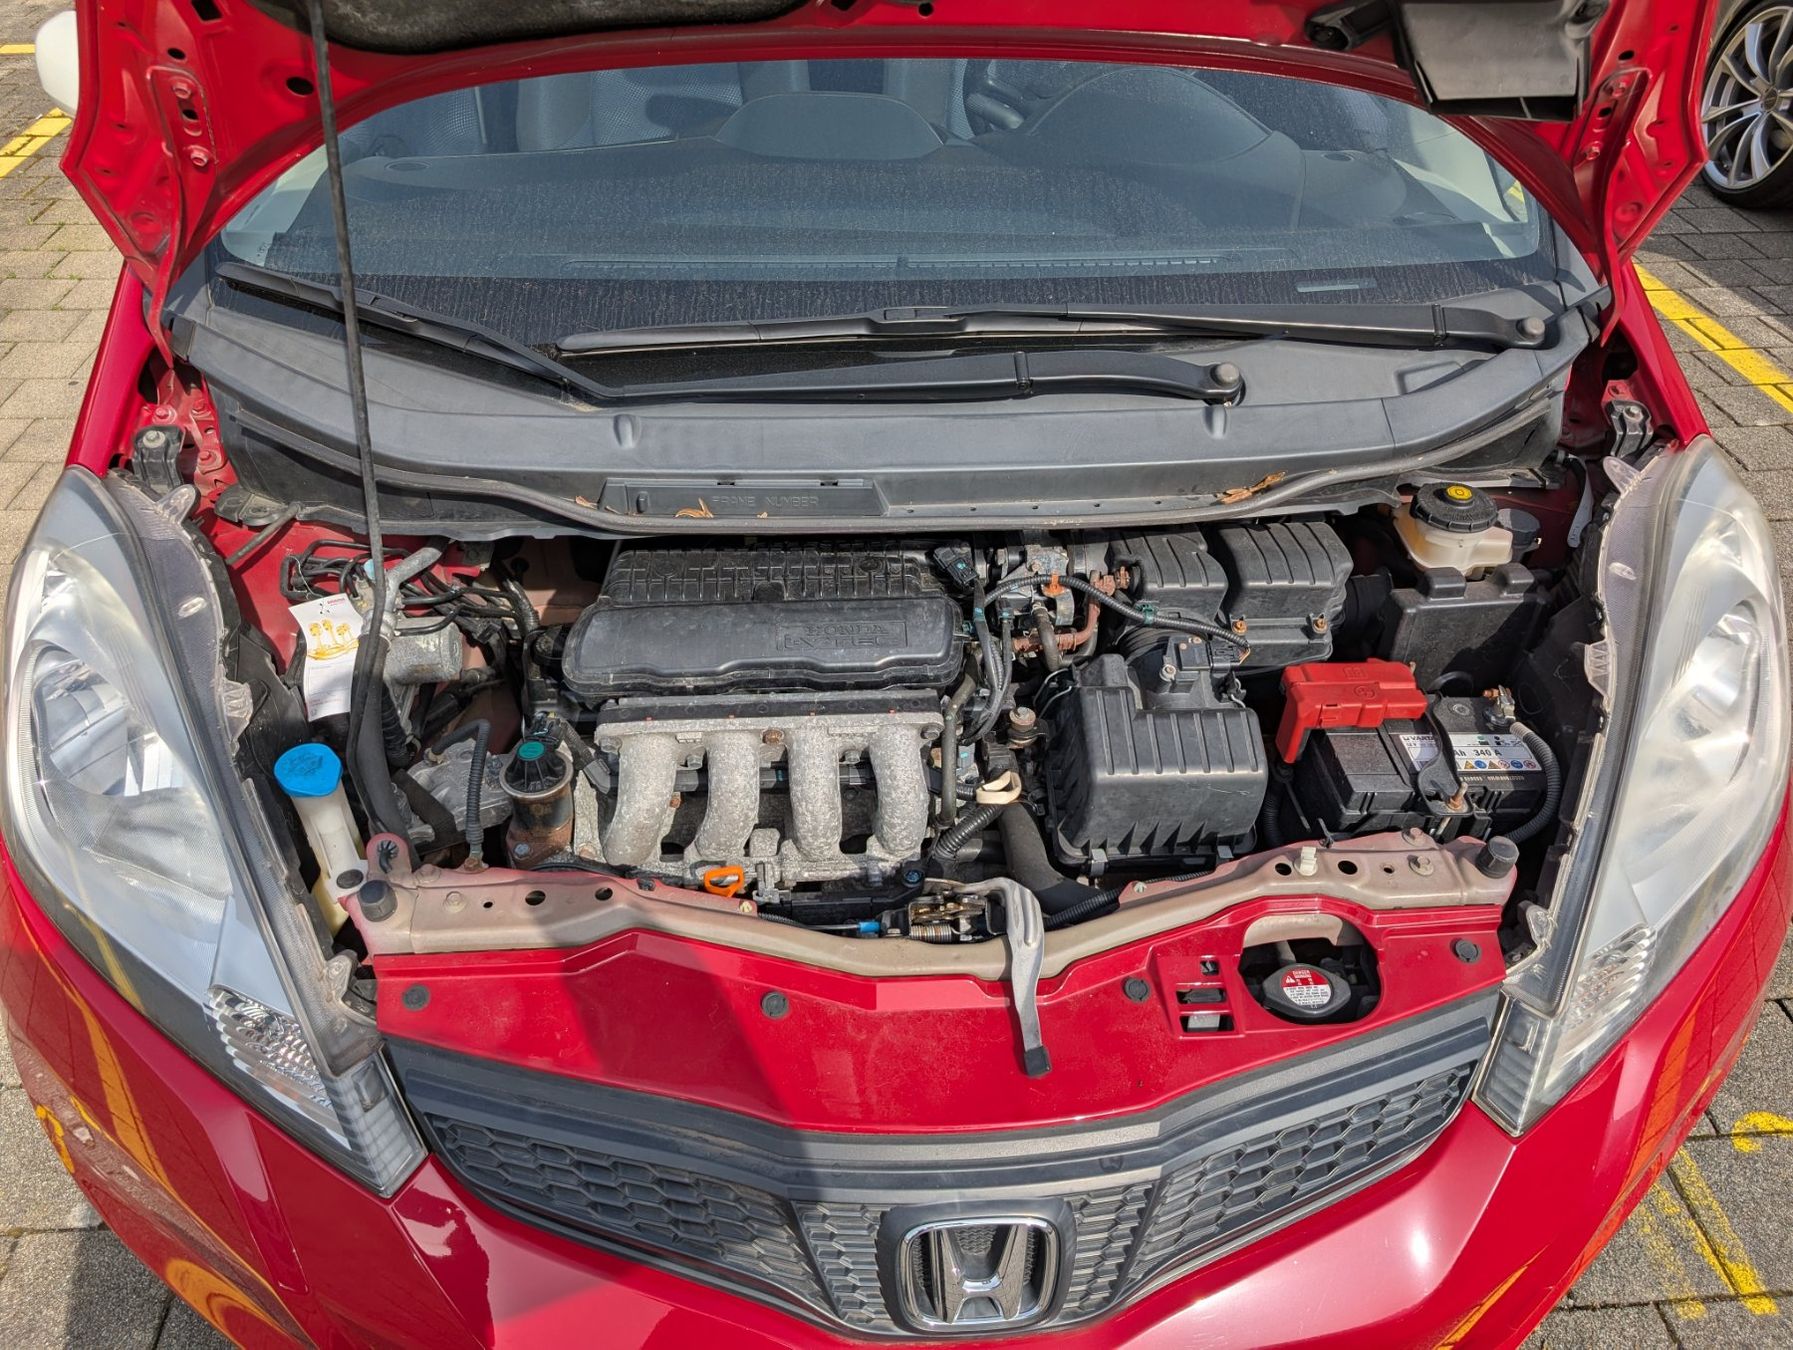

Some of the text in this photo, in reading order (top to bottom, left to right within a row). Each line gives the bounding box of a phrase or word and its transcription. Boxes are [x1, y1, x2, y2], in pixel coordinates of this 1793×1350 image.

[765, 495, 820, 507] NUMBER
[805, 623, 889, 637] HONDA
[1473, 749, 1492, 757] 340
[1494, 749, 1503, 757] A
